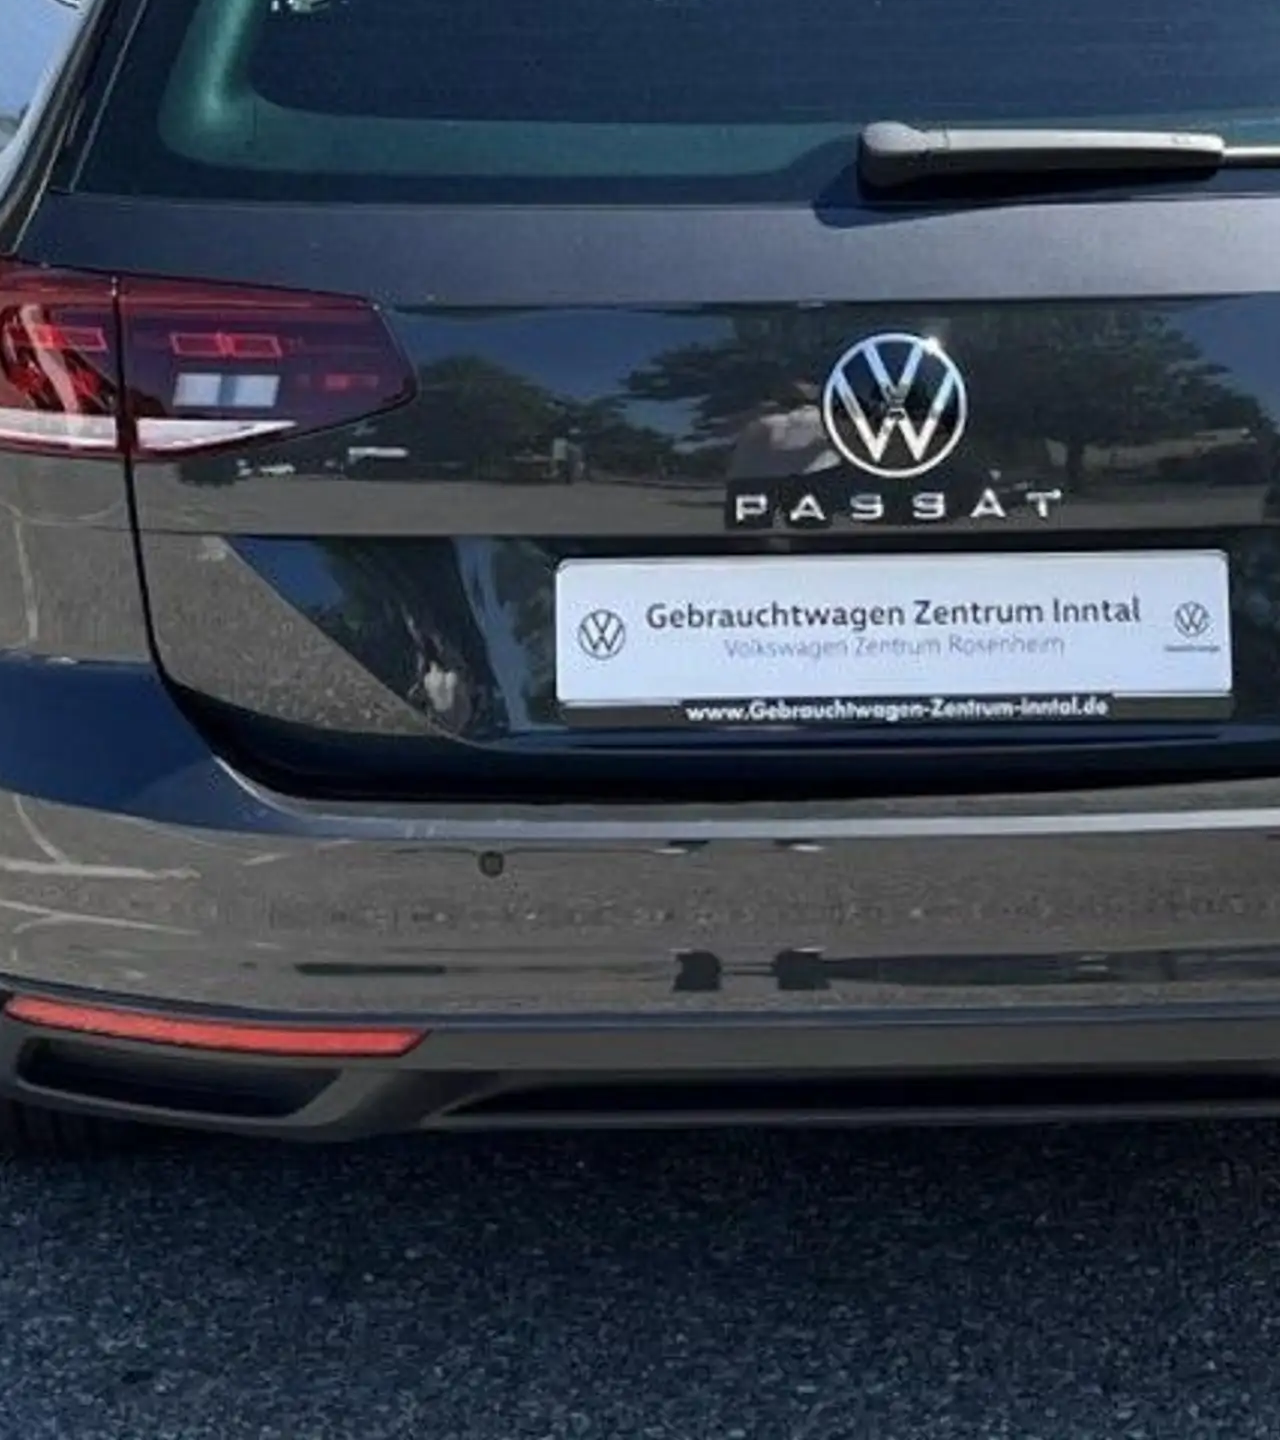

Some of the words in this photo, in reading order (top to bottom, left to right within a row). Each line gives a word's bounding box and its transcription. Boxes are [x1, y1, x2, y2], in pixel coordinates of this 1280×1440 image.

[734, 488, 1063, 523] PASSAT
[645, 601, 907, 632] Gebrauchtwagen
[913, 599, 1045, 626] Zentrum
[1052, 594, 1142, 624] Inntal
[723, 637, 849, 661] Volkswagen
[853, 635, 942, 657] Zentrum
[947, 633, 1066, 657] Rosenheim
